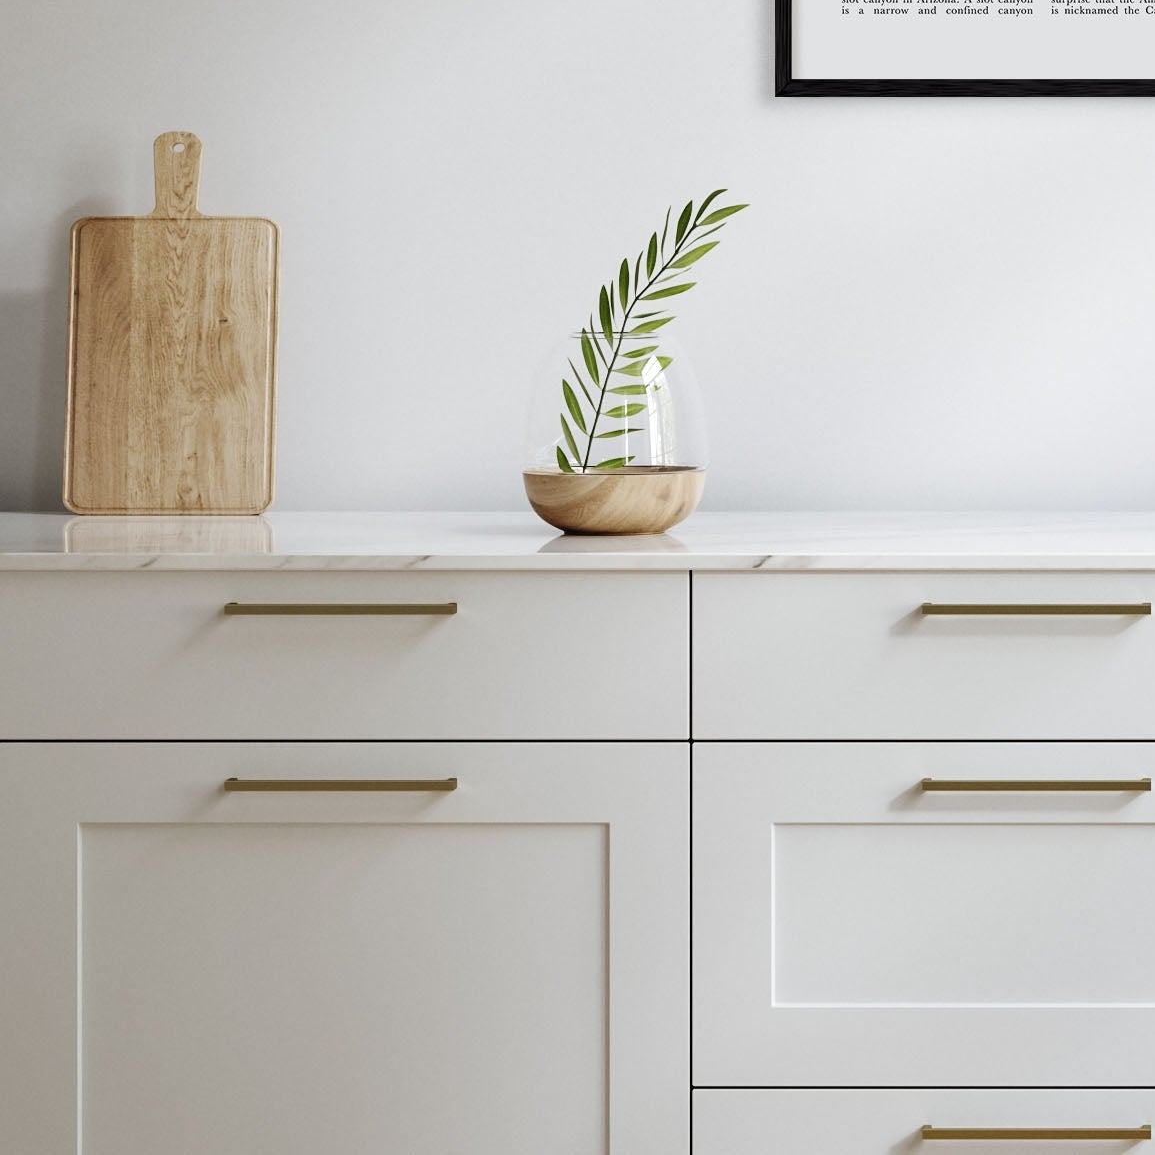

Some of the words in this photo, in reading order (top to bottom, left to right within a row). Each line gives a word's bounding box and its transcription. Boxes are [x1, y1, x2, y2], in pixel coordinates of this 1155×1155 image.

[1051, 6, 1059, 14] is
[1064, 6, 1119, 14] nicknamed
[1124, 6, 1140, 14] the
